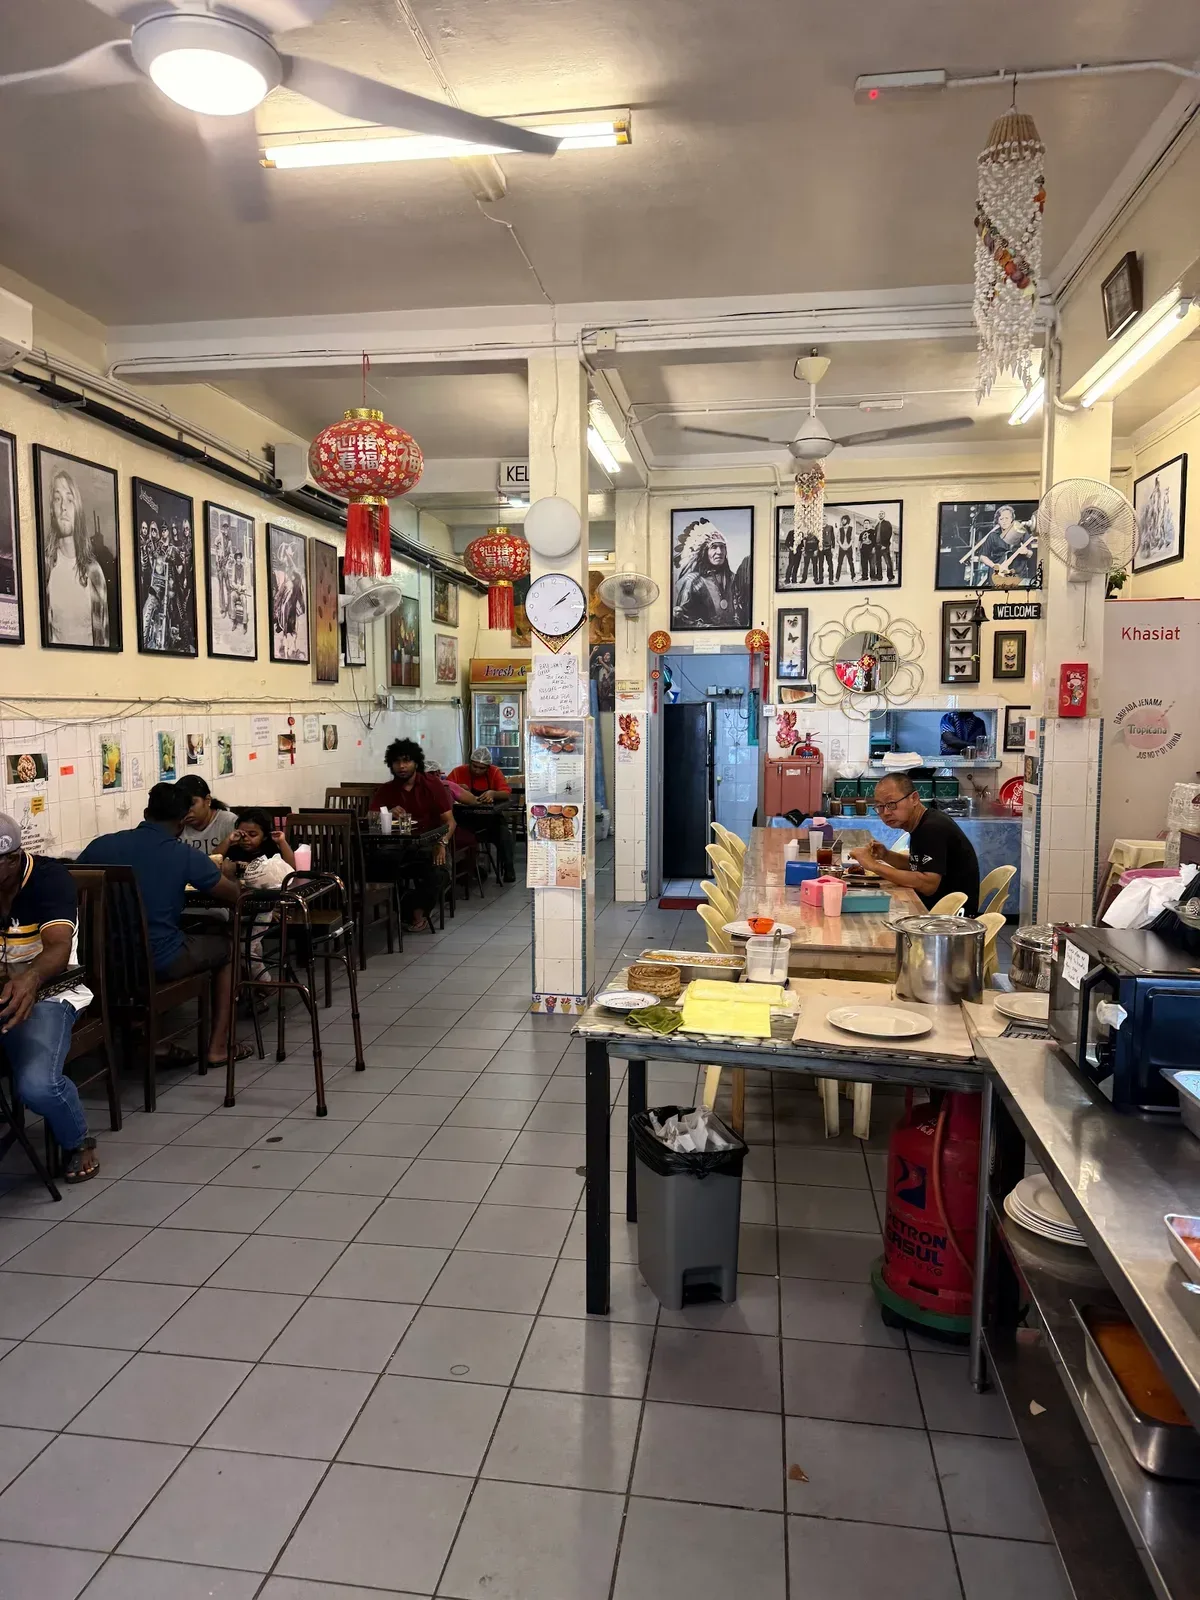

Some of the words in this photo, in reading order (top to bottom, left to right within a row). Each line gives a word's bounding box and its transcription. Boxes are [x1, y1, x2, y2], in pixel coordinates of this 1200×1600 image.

[996, 605, 1038, 618] WELCOME
[1121, 626, 1181, 641] Khasiat
[485, 664, 514, 677] Fresh
[517, 666, 526, 677] &
[1113, 701, 1138, 725] DARIPADA
[1137, 698, 1163, 707] JENAMA
[1127, 724, 1167, 735] Tropicana
[1166, 732, 1183, 750] DUNIA
[927, 1265, 942, 1277] KG
